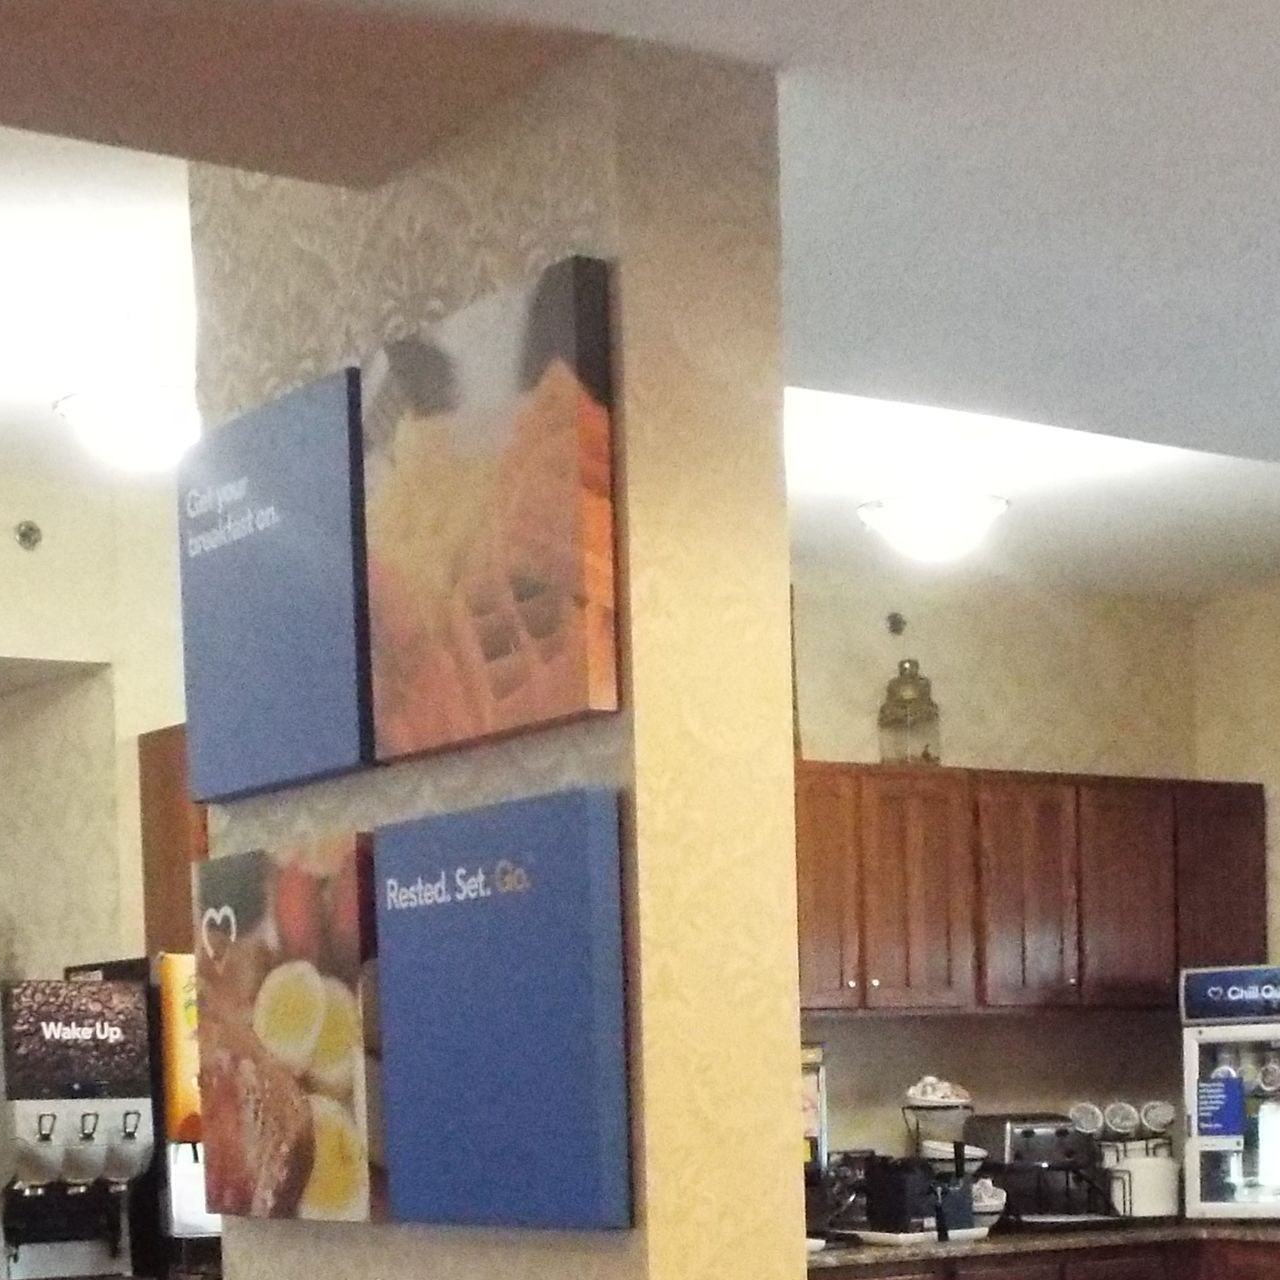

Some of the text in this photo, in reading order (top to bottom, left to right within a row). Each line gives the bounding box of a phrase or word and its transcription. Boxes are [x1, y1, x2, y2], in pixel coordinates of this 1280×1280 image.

[386, 869, 451, 911] Rested.
[454, 867, 491, 901] Set.
[1227, 984, 1259, 1001] Chill
[40, 1021, 126, 1044] Wake Up
